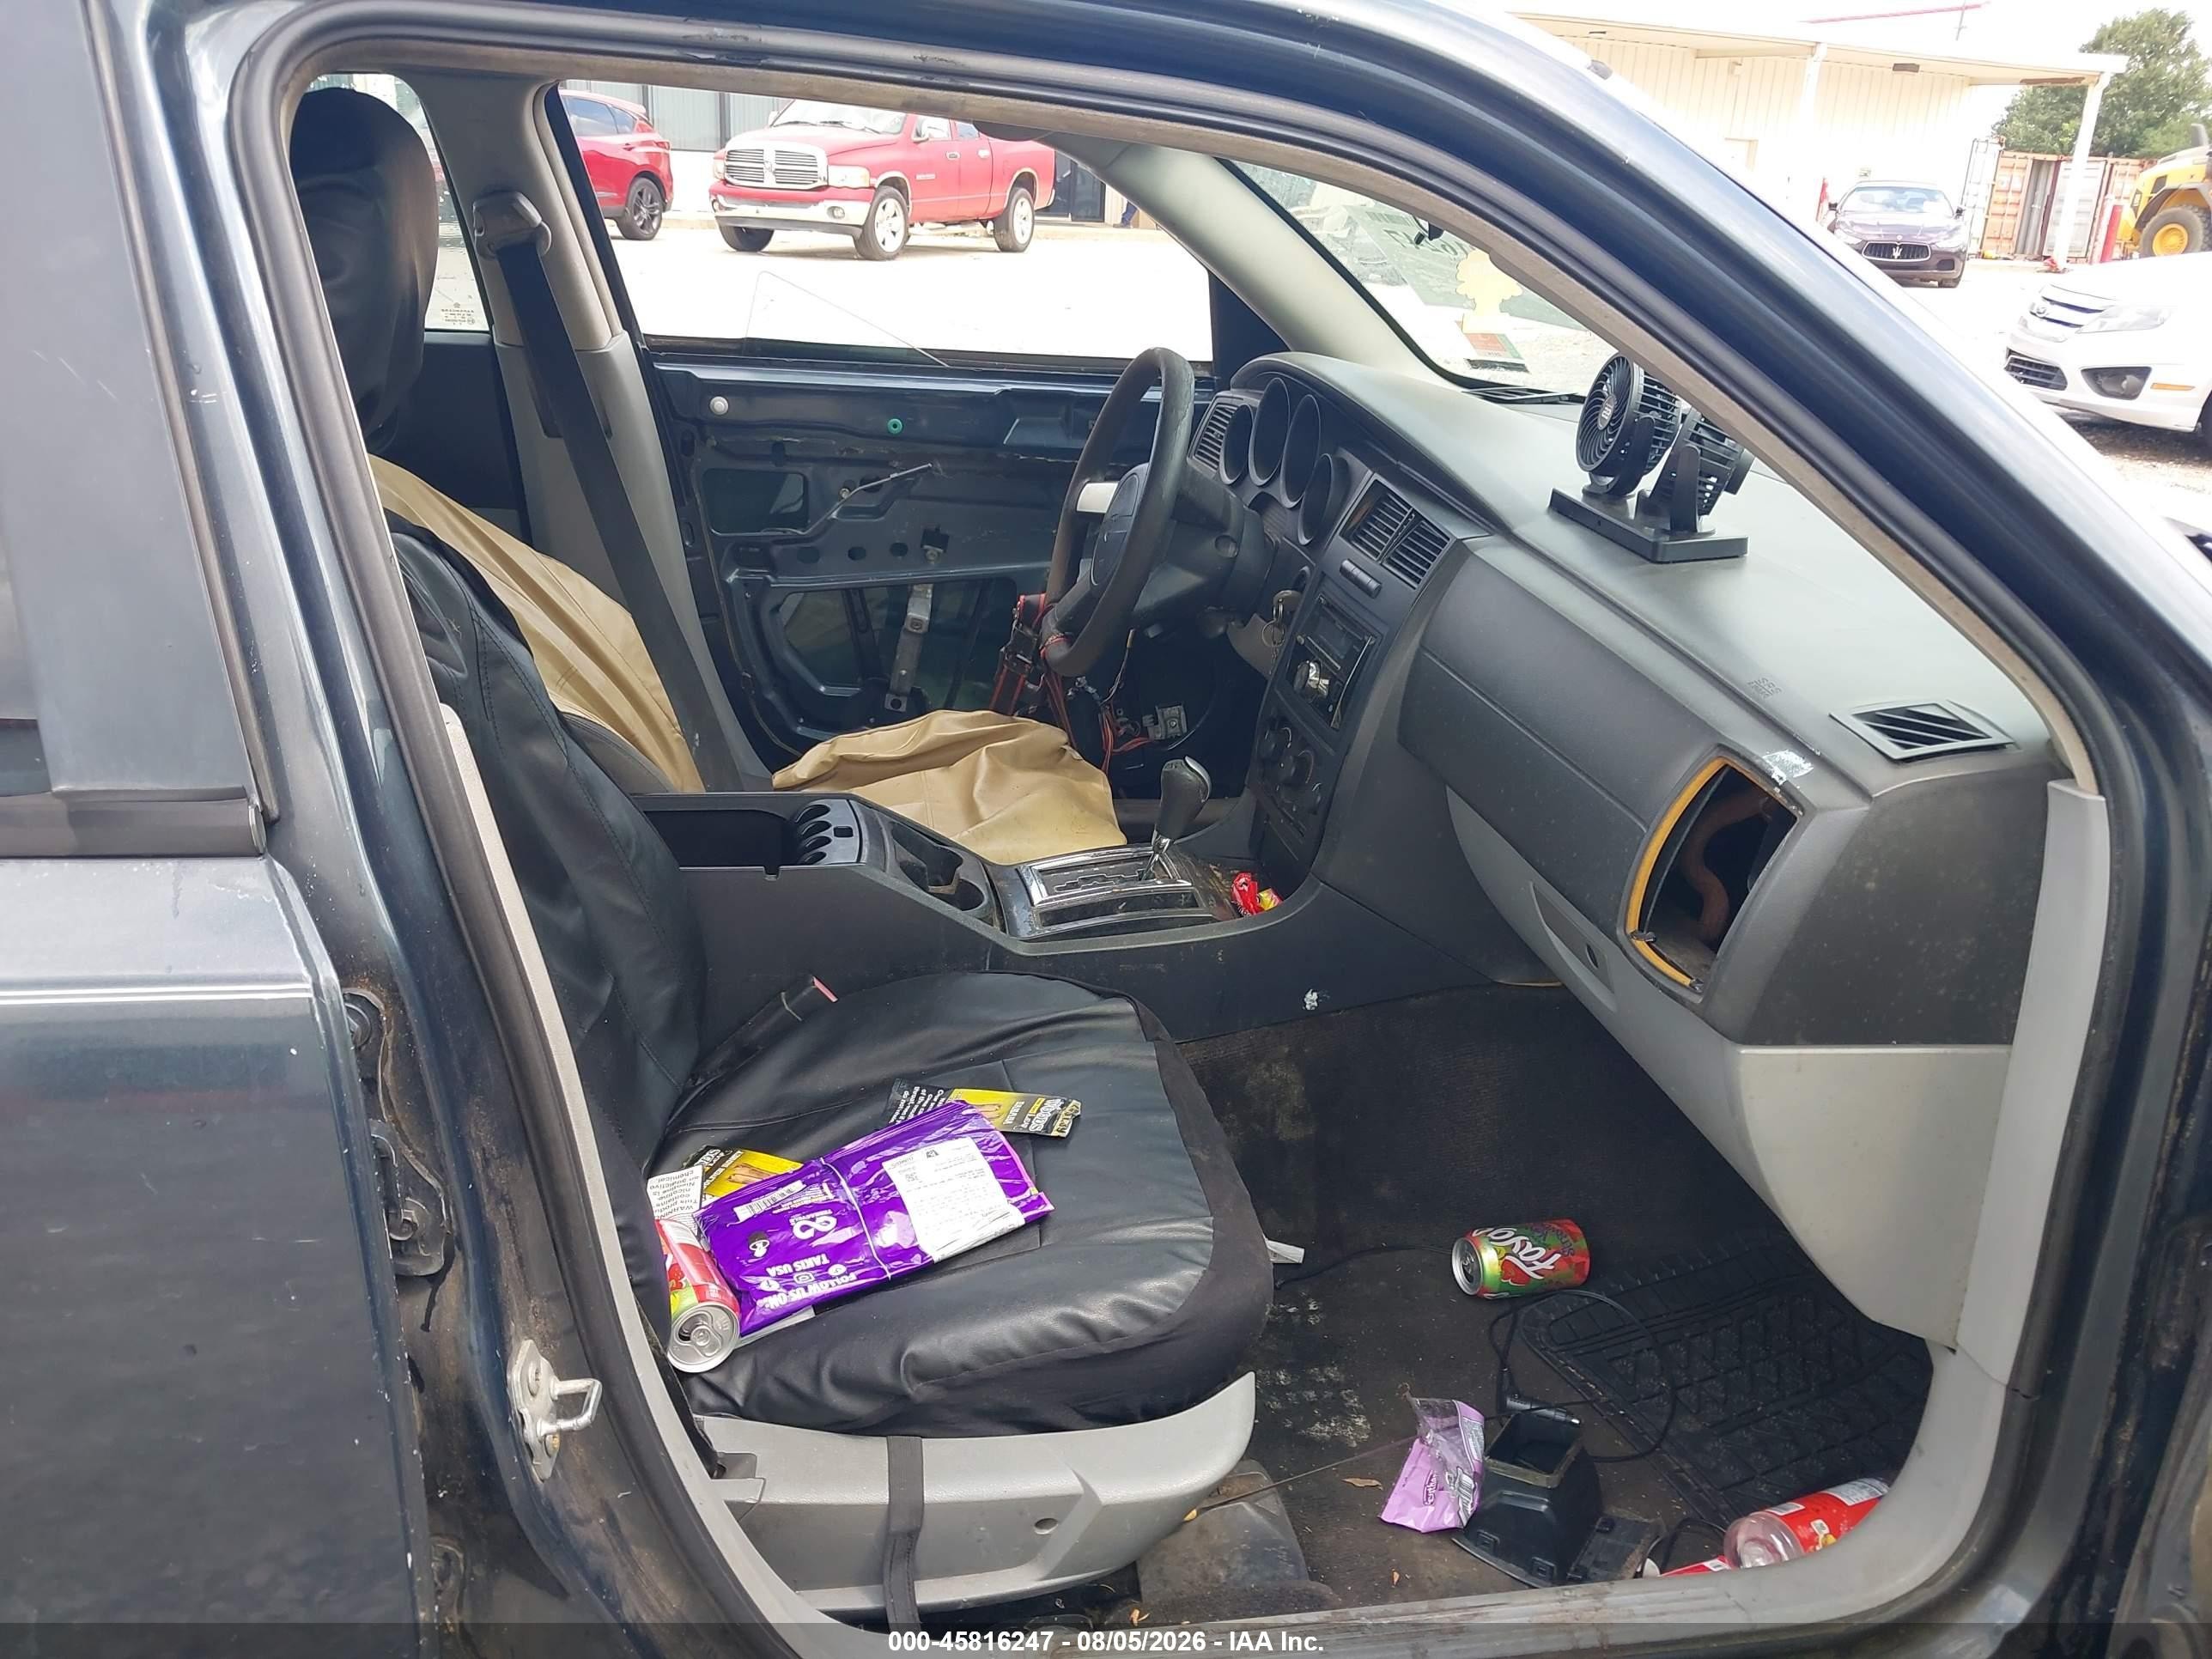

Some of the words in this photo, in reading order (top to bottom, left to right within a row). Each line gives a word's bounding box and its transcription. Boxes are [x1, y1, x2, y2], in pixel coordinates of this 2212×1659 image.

[765, 1263, 793, 1277] USA
[793, 1253, 830, 1272] TAKIS
[807, 1272, 857, 1293] FOLLOW
[788, 1287, 806, 1301] US
